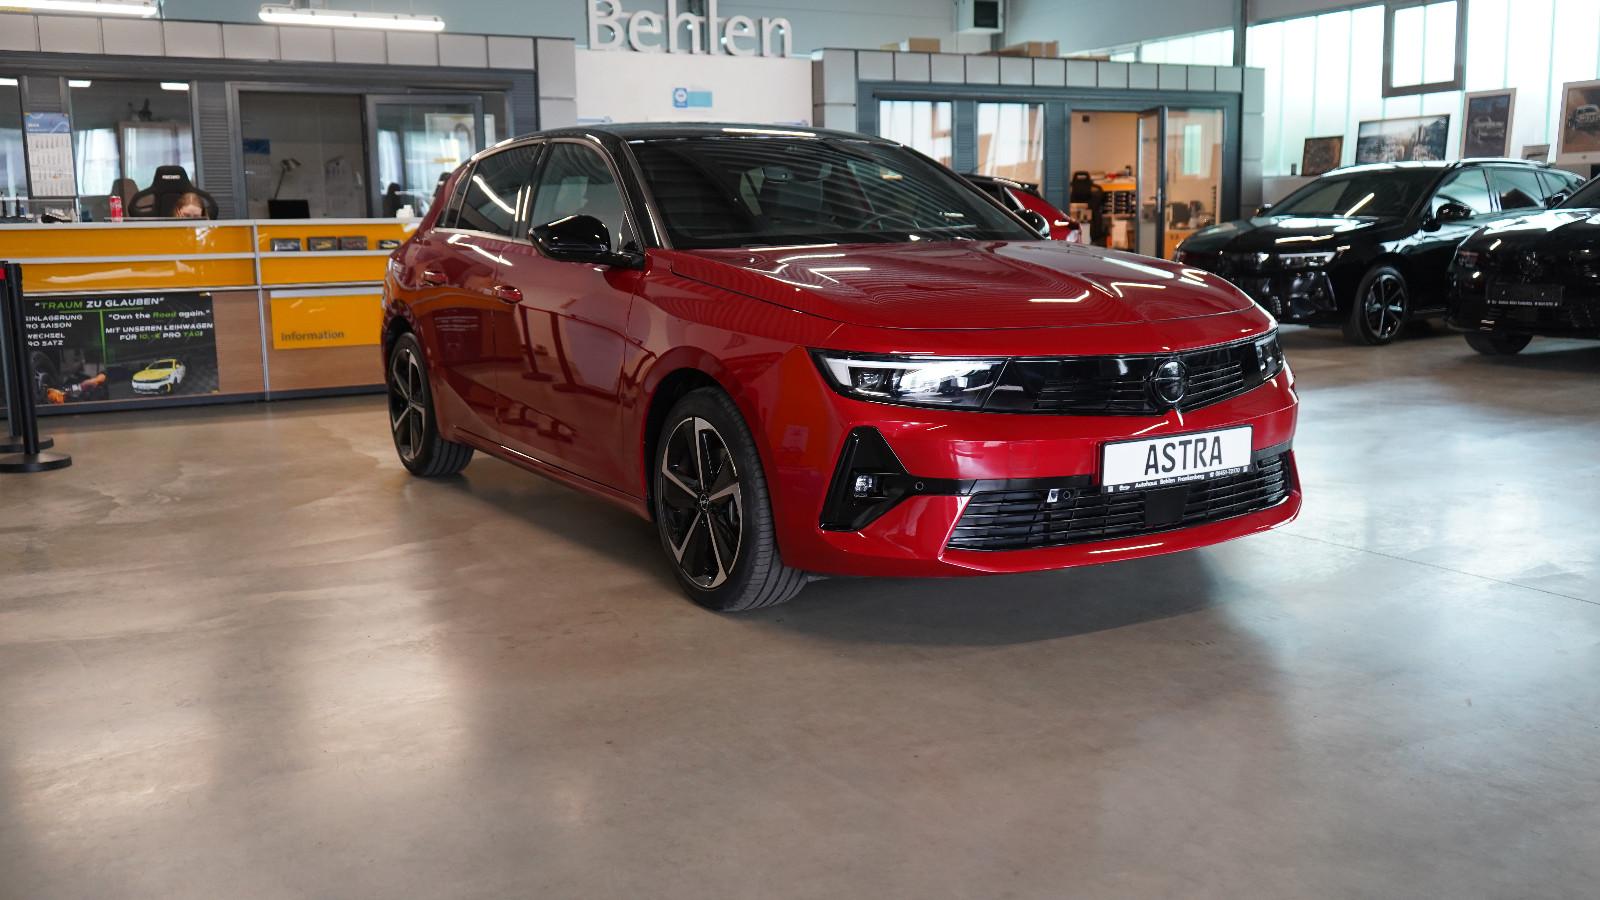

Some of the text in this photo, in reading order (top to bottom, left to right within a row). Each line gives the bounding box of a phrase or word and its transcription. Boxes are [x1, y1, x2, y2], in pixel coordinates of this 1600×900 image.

[587, 0, 792, 57] Behlen
[86, 300, 102, 308] ZU
[135, 311, 151, 319] the
[153, 310, 177, 318] Road
[40, 321, 72, 329] SAISON
[105, 322, 213, 334] MIT UNSEREN LEIHWAGEN
[119, 333, 137, 341] FÜR
[162, 331, 181, 339] PRO
[41, 339, 64, 347] SATZ
[1144, 435, 1222, 475] ASTRA
